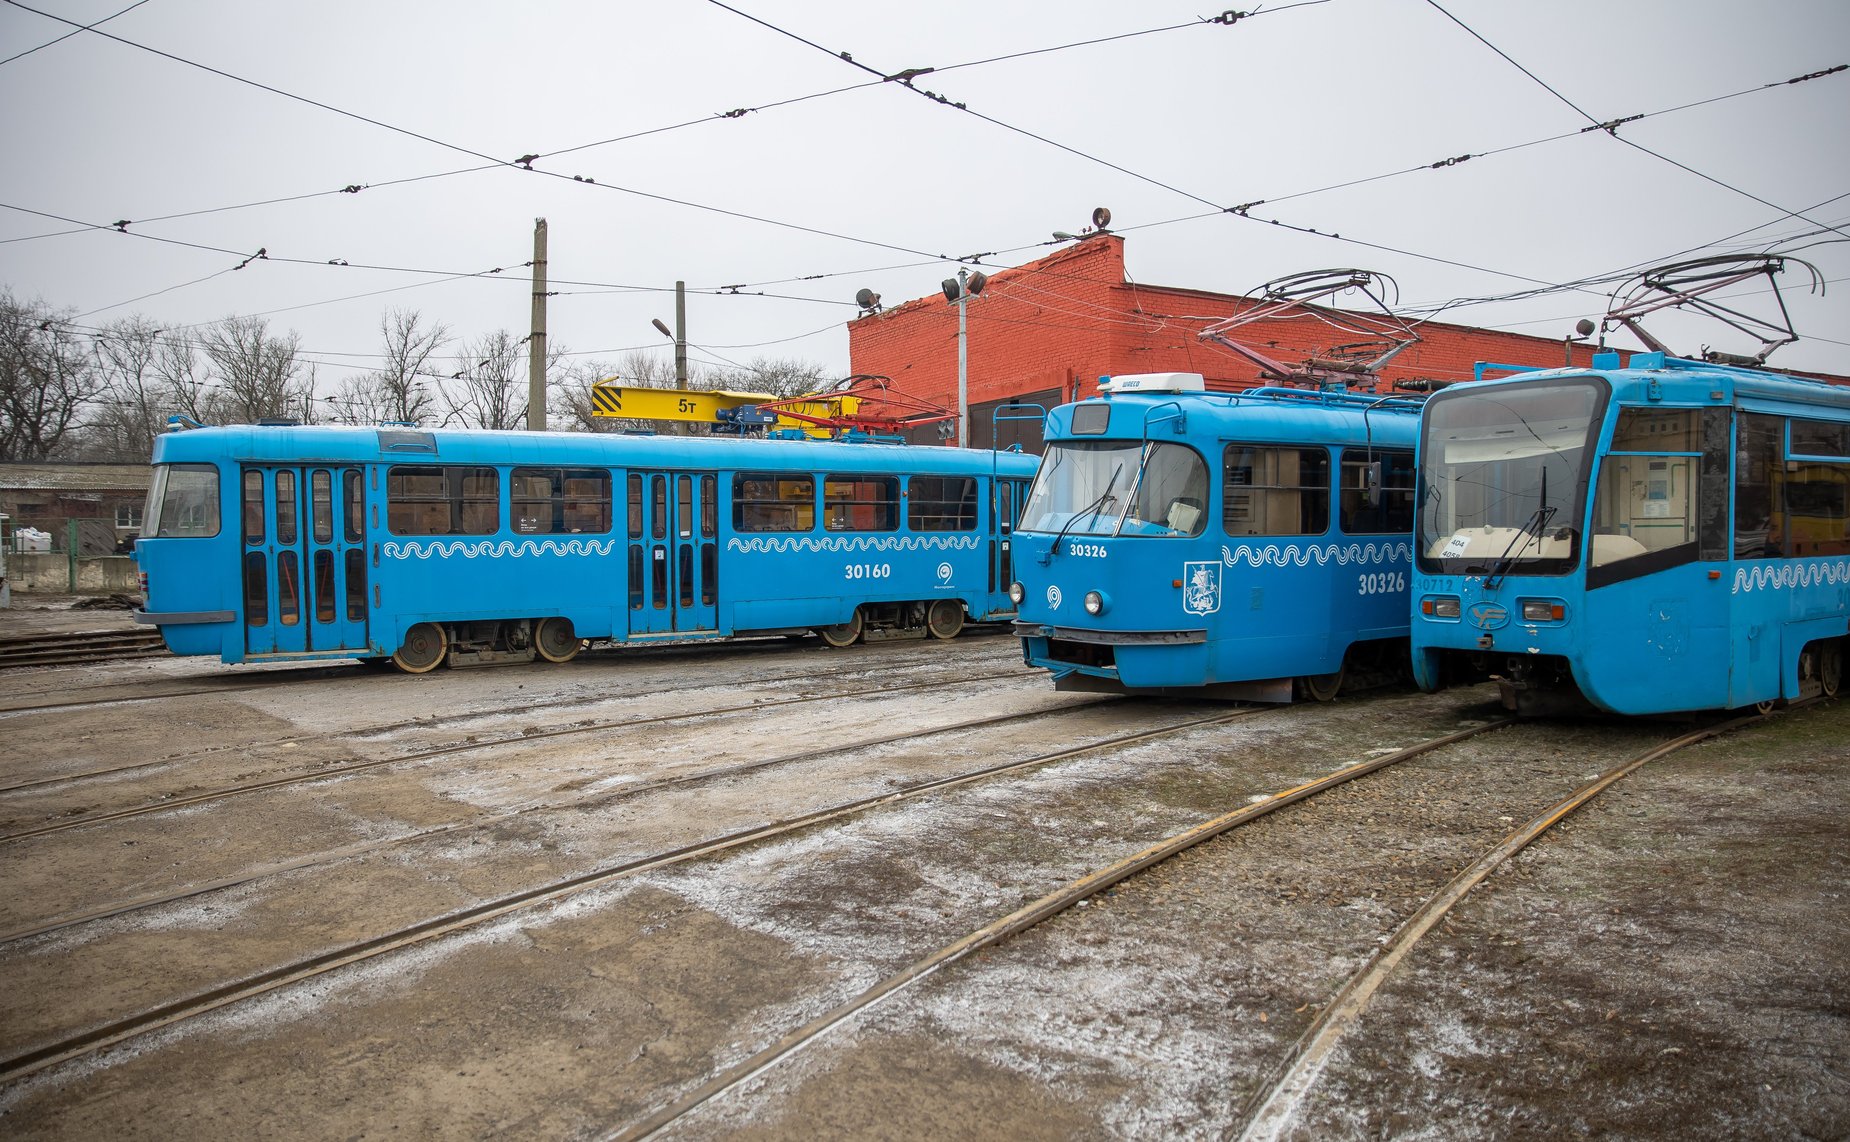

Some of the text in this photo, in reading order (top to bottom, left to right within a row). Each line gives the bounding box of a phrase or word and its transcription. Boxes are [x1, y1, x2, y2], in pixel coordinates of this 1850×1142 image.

[1070, 543, 1107, 558] 30326
[1451, 539, 1465, 548] 404
[844, 563, 891, 580] 30160
[1358, 571, 1405, 596] 30326
